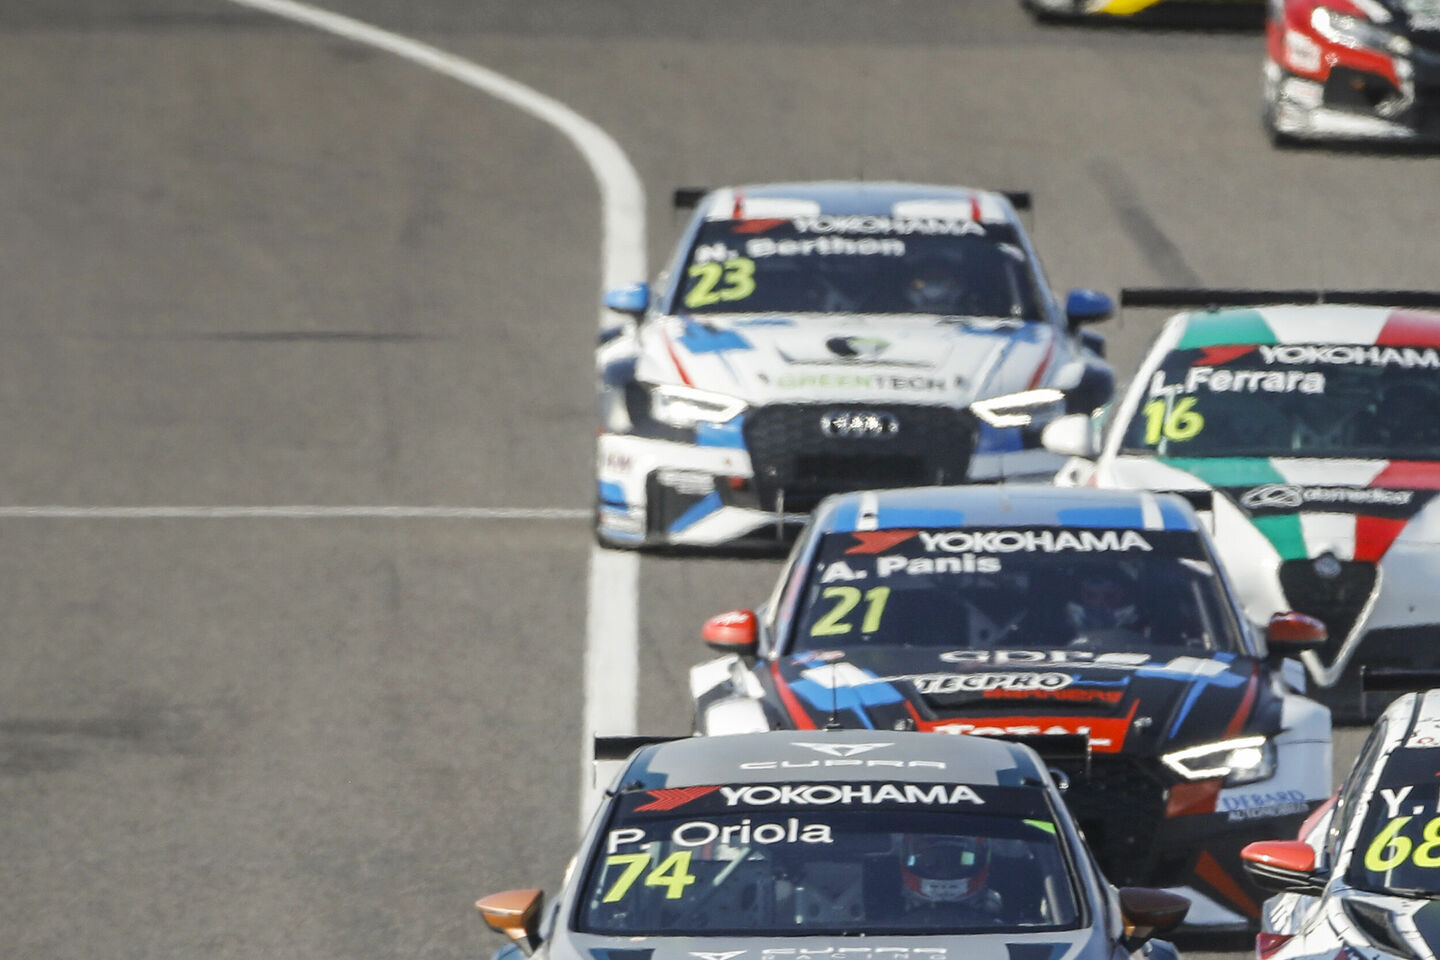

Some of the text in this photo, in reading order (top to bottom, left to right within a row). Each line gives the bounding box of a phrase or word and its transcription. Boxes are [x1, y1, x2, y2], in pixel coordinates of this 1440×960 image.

[684, 257, 756, 309] 23
[1142, 397, 1205, 445] 16
[918, 530, 1153, 553] YOKOHAMA
[820, 553, 1002, 584] A. Panis
[809, 585, 892, 638] 21
[915, 673, 1074, 694] TECPRO
[739, 759, 947, 770] CUPRA
[719, 784, 985, 806] YOKOHAMA
[1380, 785, 1425, 818] Y.
[606, 817, 834, 854] P. Oriola
[602, 850, 697, 904] 74
